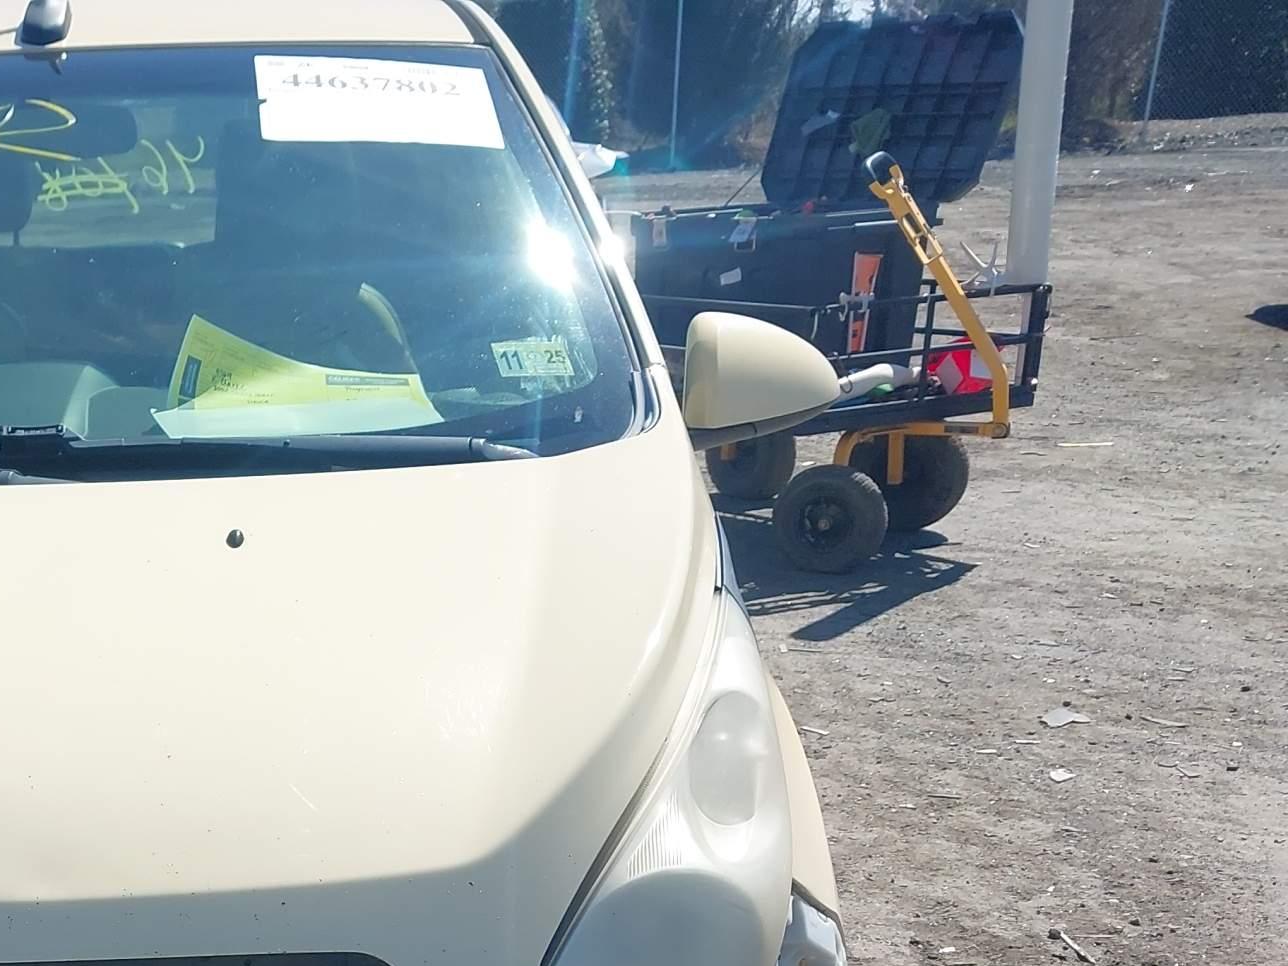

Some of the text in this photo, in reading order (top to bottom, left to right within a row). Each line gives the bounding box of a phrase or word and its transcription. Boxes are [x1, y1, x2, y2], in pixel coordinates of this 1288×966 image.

[282, 73, 460, 96] 44637802
[500, 350, 567, 370] 11 25
